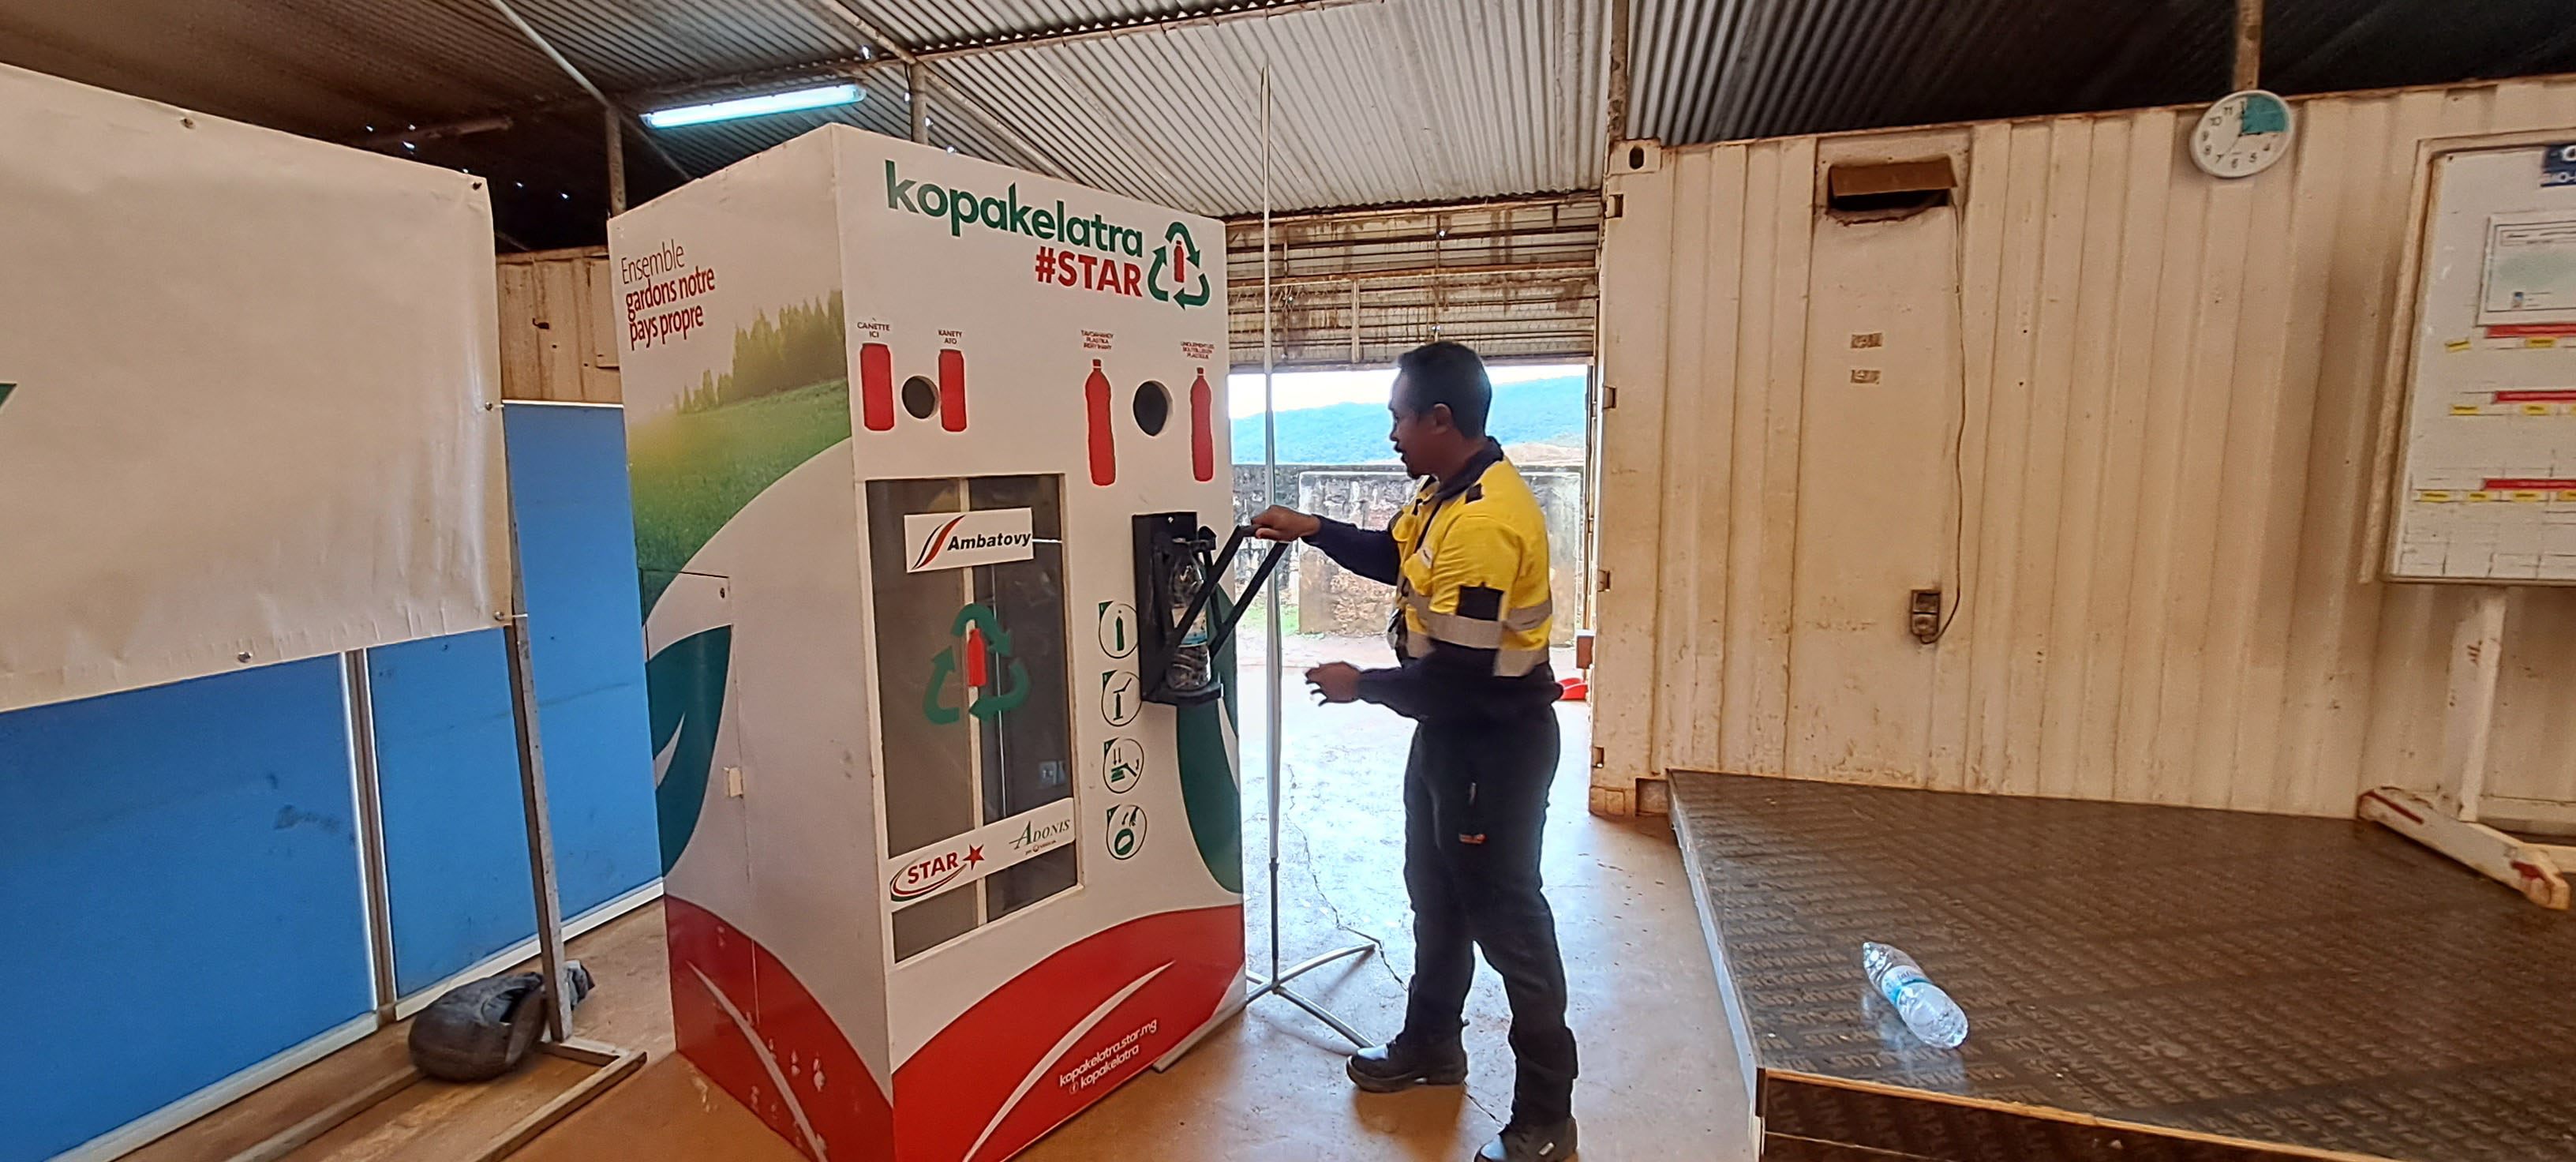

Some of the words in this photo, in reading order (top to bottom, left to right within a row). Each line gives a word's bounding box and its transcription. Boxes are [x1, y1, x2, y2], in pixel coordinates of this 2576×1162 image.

[885, 159, 1143, 258] kopakelatra
[621, 238, 685, 284] Ensemble
[1035, 246, 1143, 298] #STAR
[626, 278, 677, 323] gardons
[679, 265, 716, 299] notre
[629, 317, 658, 351] pays
[659, 305, 703, 345] propre
[856, 321, 891, 332] CANETTE
[947, 533, 1032, 551] Ambatovy
[1009, 819, 1071, 850] ADONIS
[907, 851, 960, 885] STAR
[1059, 1018, 1158, 1087] kopakelatra.star.mg
[1080, 1044, 1140, 1089] kopakelatra
